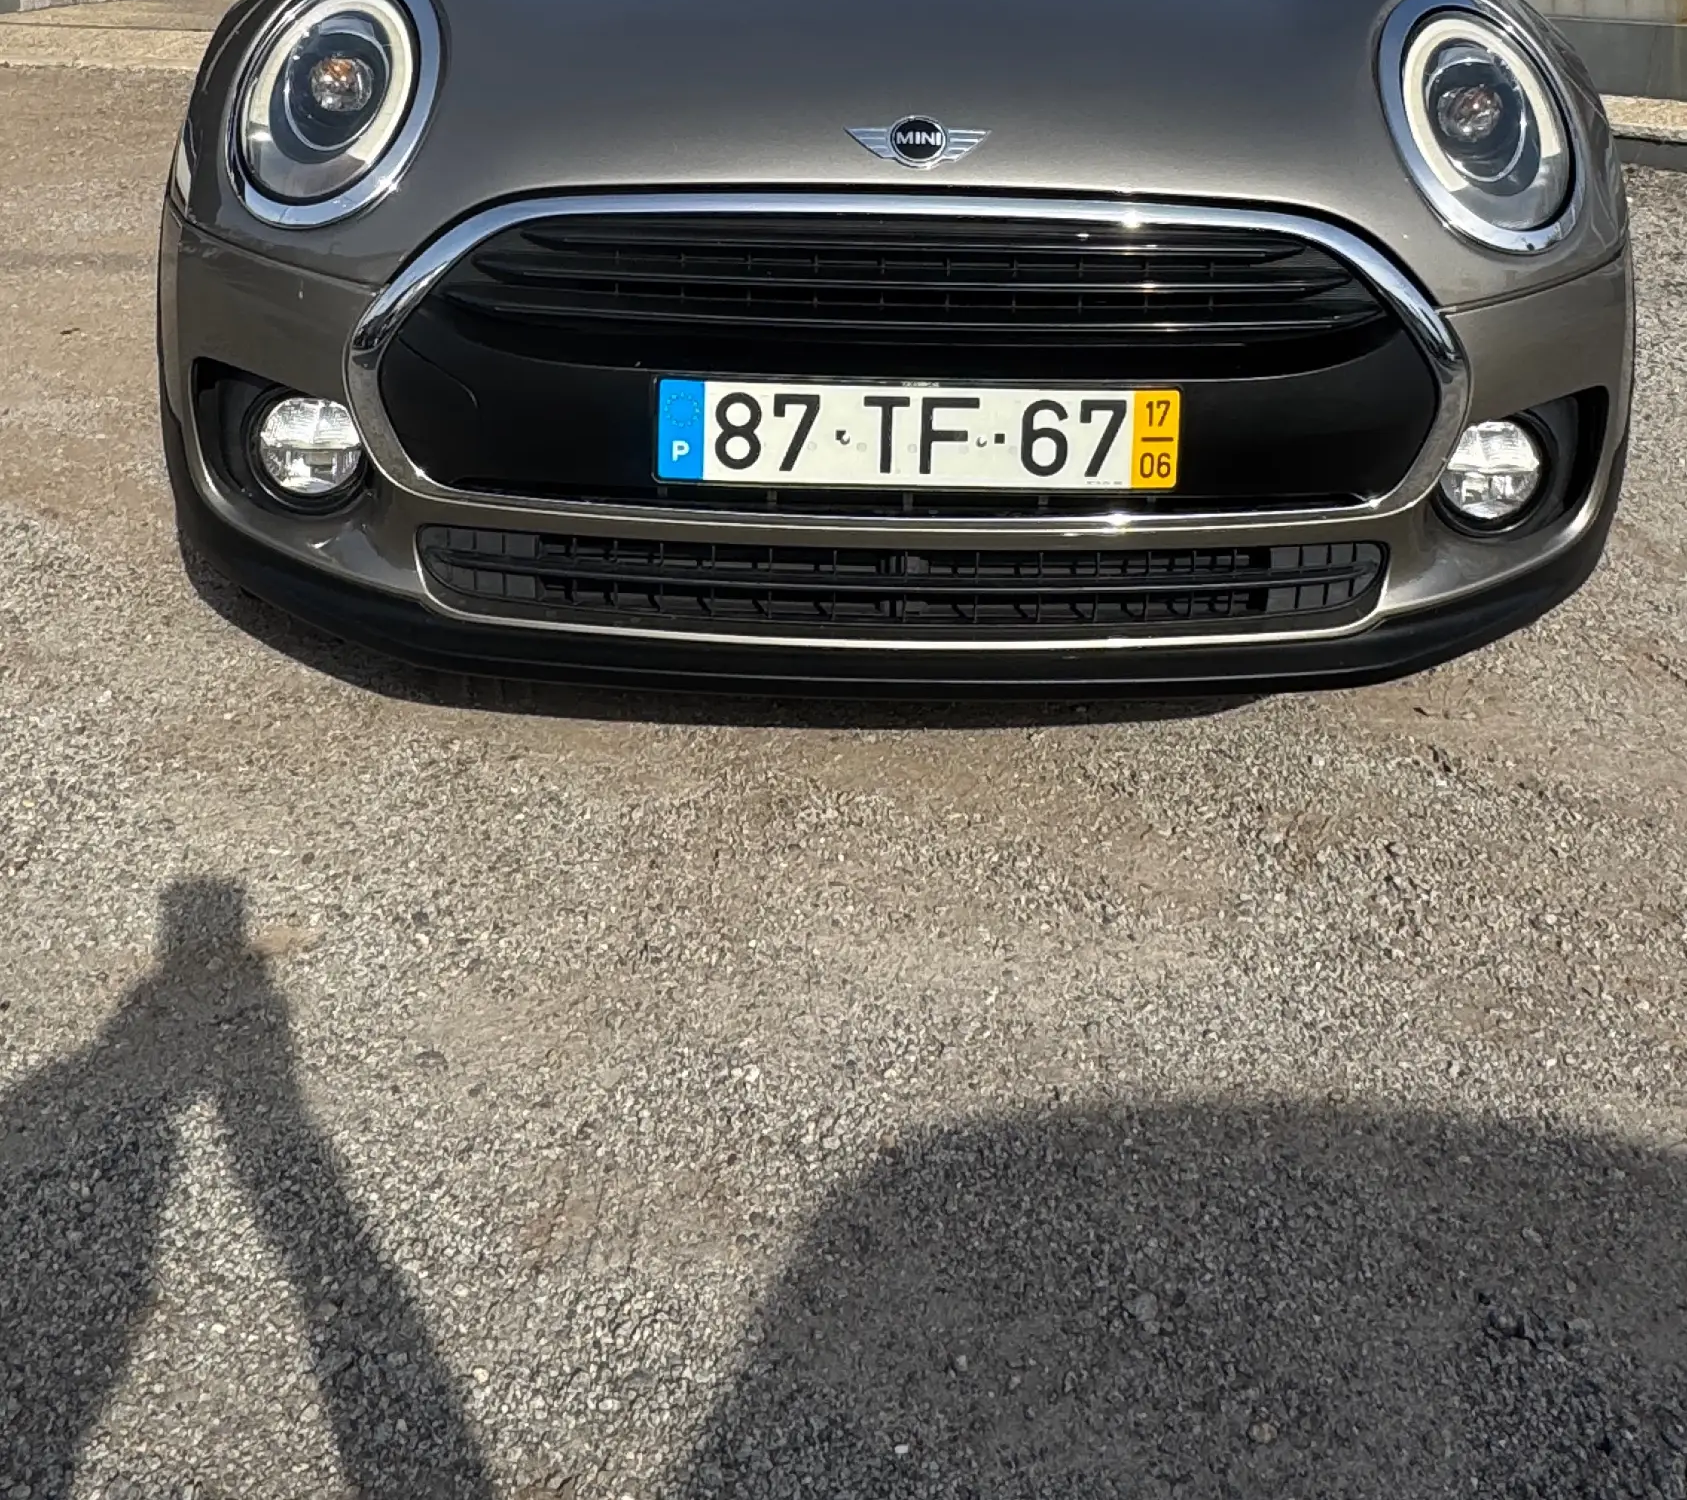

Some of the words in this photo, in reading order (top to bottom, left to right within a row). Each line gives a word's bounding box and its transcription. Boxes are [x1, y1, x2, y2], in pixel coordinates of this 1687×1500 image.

[896, 131, 941, 146] MINI
[1145, 399, 1171, 428] 17
[671, 441, 690, 462] P
[1138, 452, 1172, 479] 06
